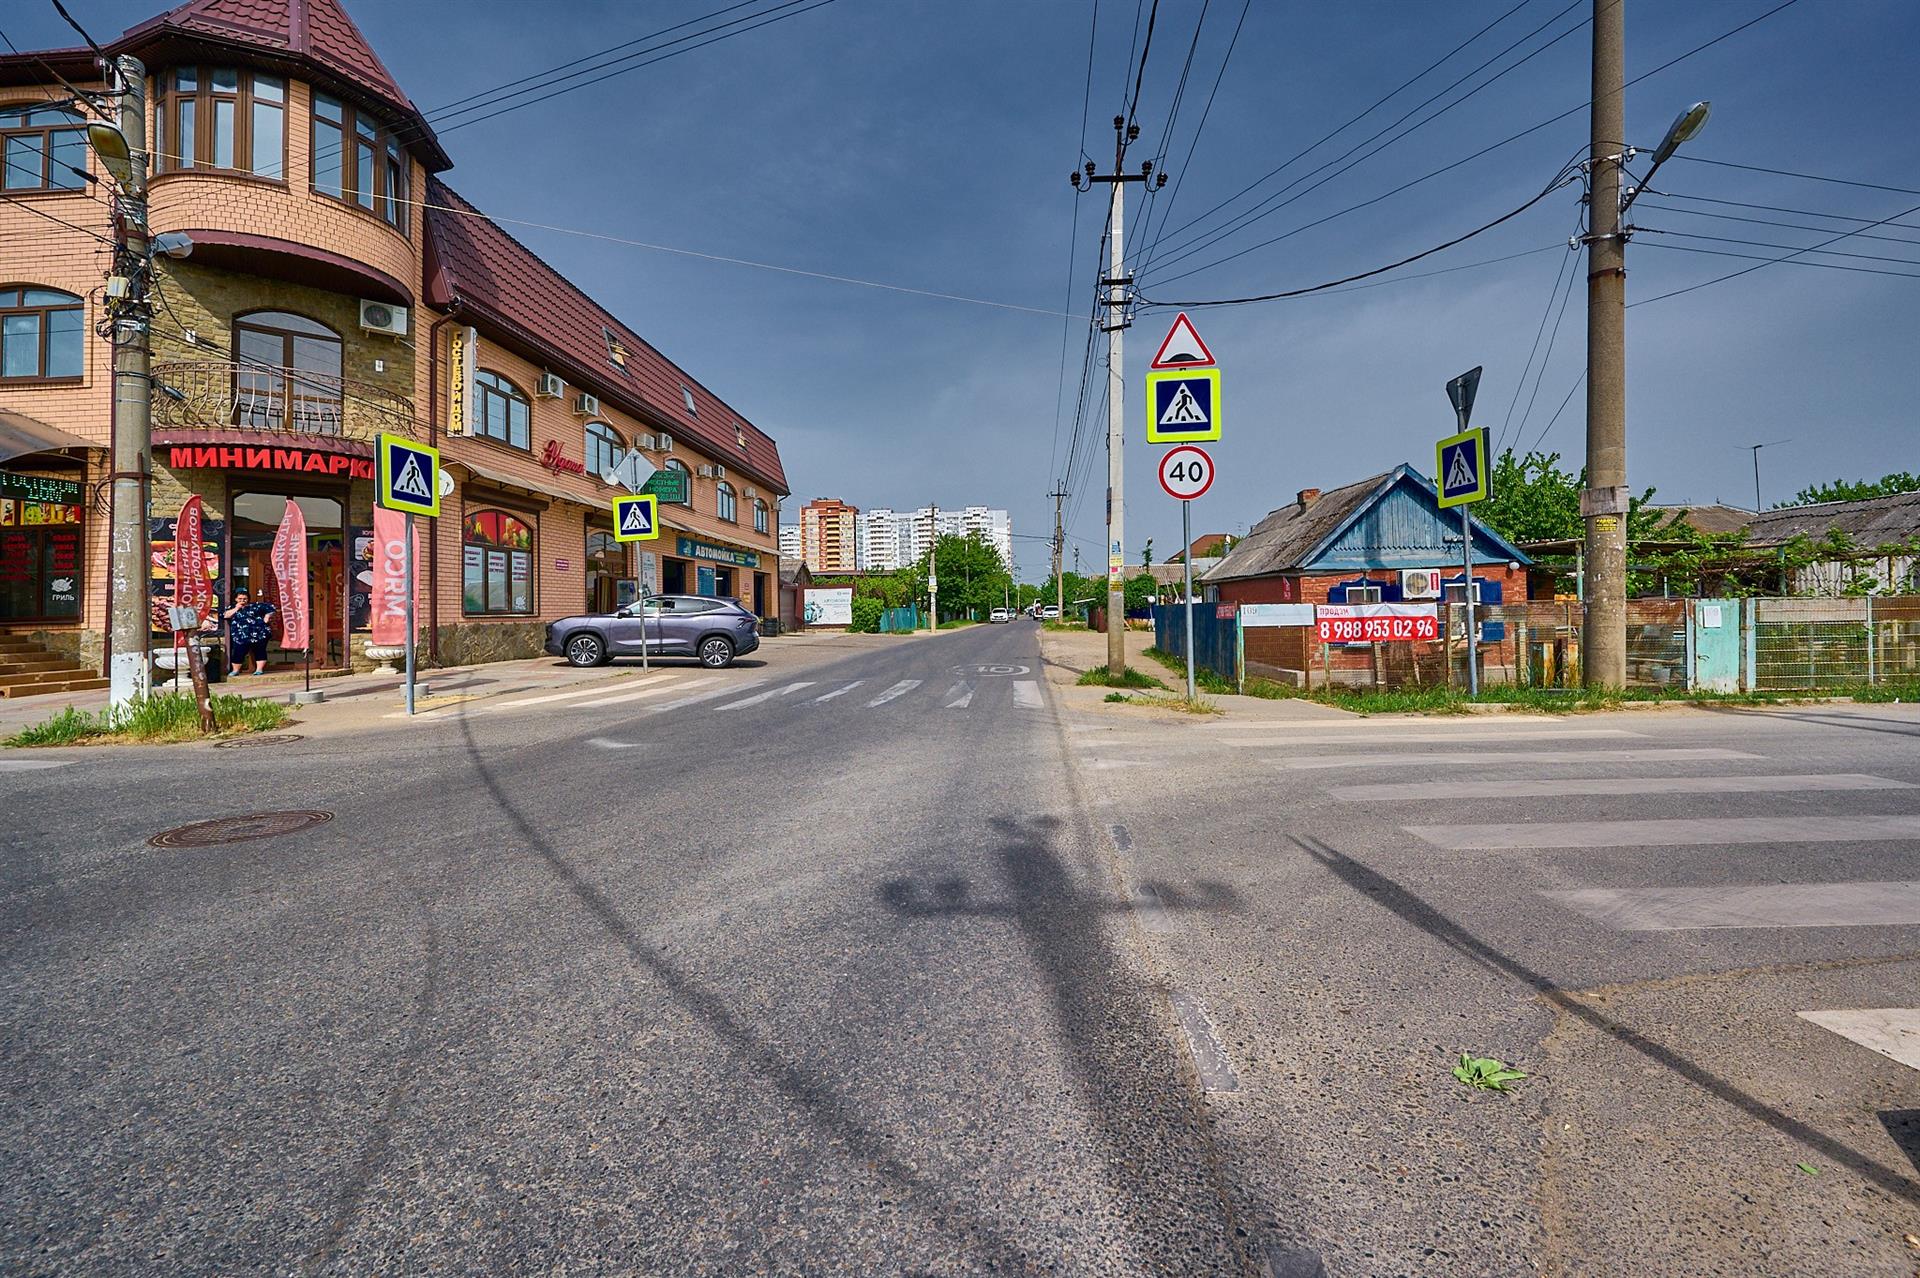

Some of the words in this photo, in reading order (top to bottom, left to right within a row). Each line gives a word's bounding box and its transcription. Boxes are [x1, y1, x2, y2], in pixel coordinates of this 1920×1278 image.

[170, 448, 375, 480] МИНИМАРК
[1169, 461, 1203, 483] 40
[189, 507, 206, 587] ПРОДУКТОВ
[695, 545, 735, 562] АВТОМОЙКА
[180, 540, 193, 607] ОПЧЕНИЕ
[1320, 621, 1330, 639] 8
[1333, 620, 1362, 638] 988
[1365, 619, 1389, 637] 953
[1393, 619, 1412, 637] 02
[1416, 619, 1433, 637] 96
